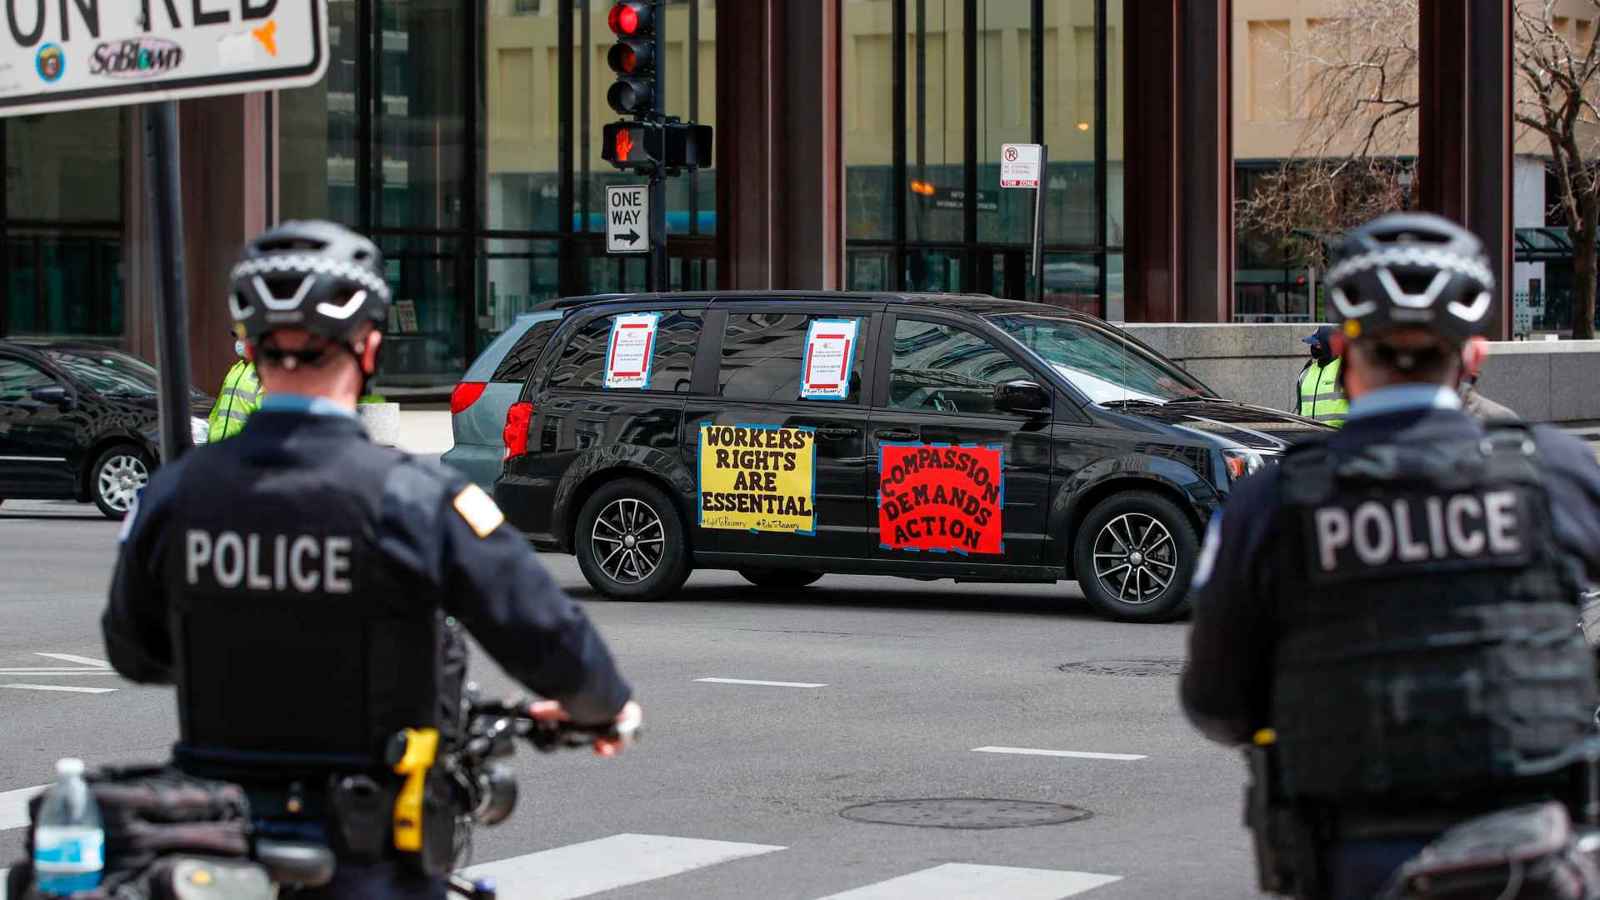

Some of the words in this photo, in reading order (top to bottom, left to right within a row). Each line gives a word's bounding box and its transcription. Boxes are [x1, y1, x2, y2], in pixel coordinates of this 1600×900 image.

[611, 191, 642, 207] ONE
[611, 210, 641, 225] WAY
[706, 426, 813, 450] WORKERS'
[716, 448, 797, 471] RIGHTS
[733, 471, 777, 492] ARE
[881, 447, 1000, 505] COMPASSION
[702, 491, 812, 517] ESSENTIAL
[883, 483, 993, 527] DEMANDS
[894, 516, 982, 550] ACTION
[1314, 490, 1522, 572] POLICE
[185, 528, 352, 594] POLICE
